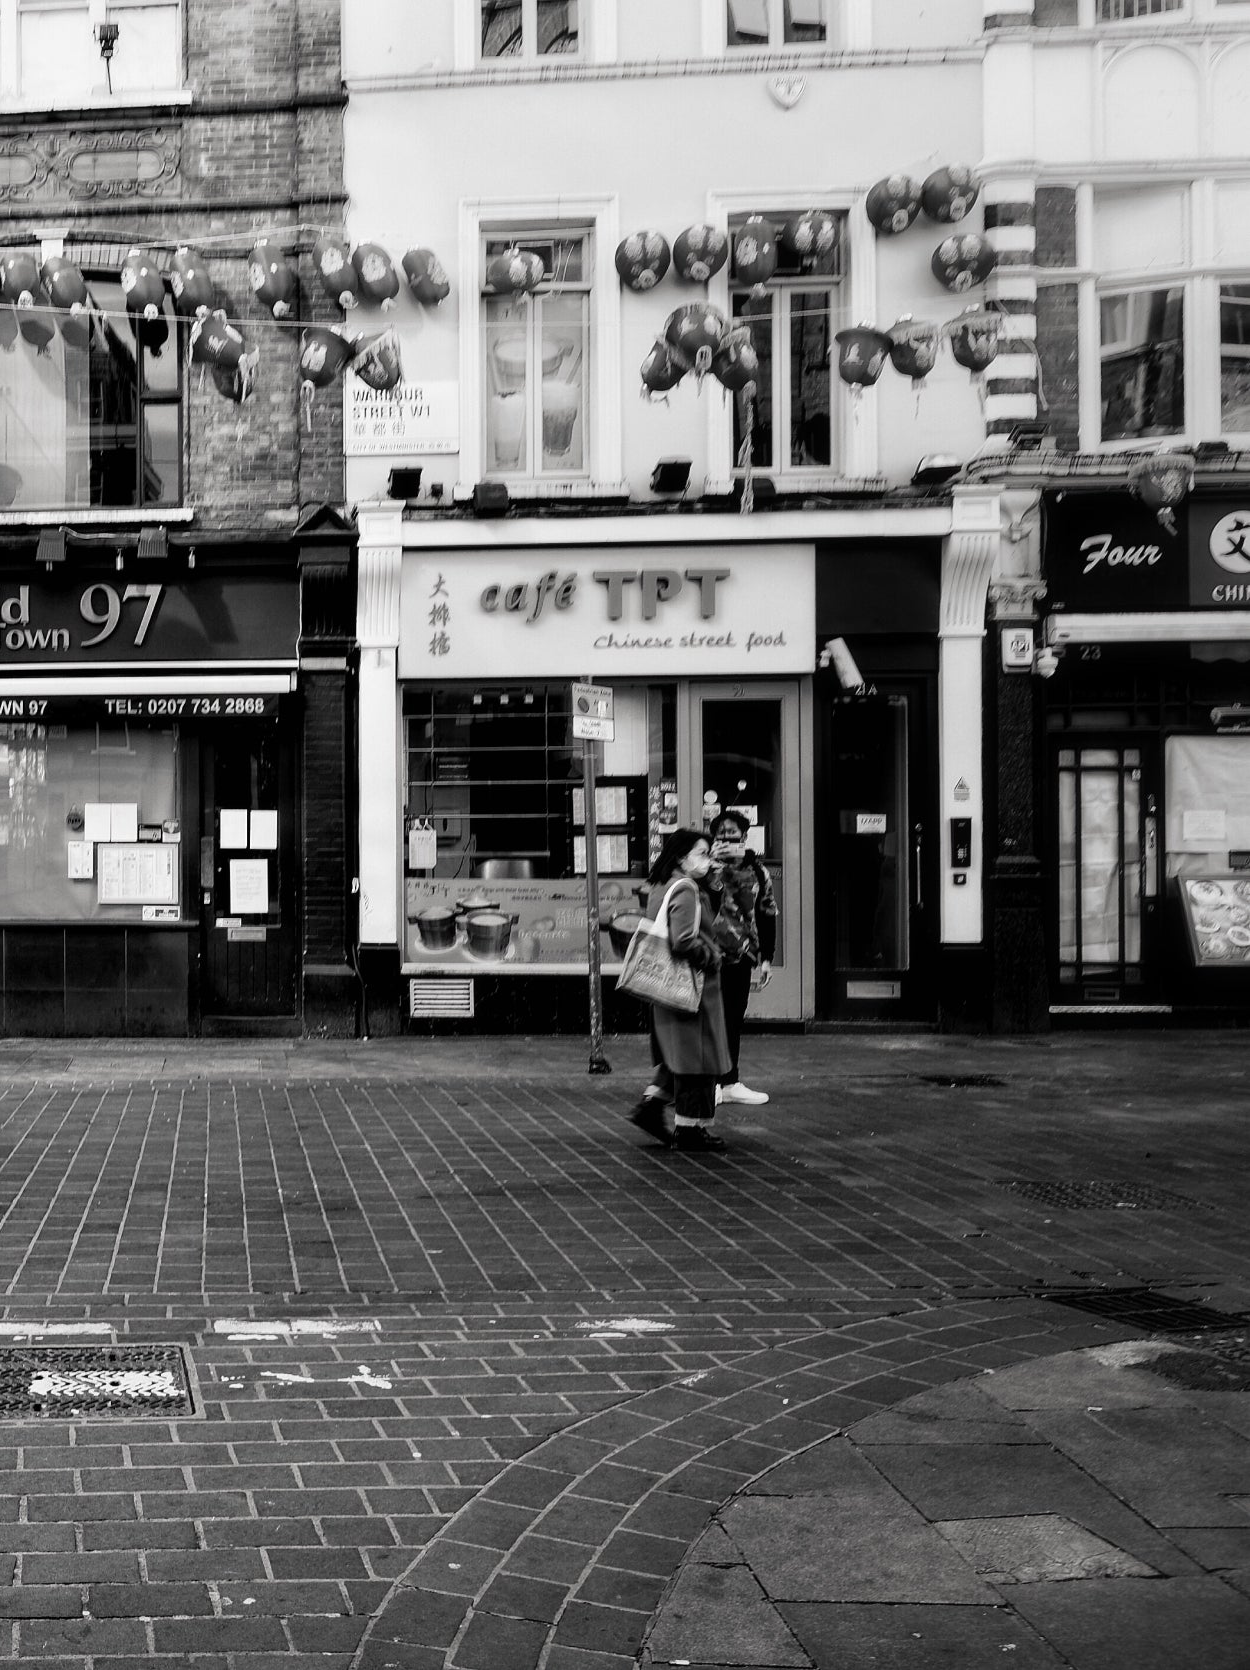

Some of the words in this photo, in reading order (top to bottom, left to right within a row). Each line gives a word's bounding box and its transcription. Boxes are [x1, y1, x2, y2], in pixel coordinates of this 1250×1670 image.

[353, 405, 404, 418] STREET
[410, 404, 430, 417] W1
[1079, 533, 1163, 575] Four
[479, 568, 578, 625] café
[592, 567, 731, 622] TPT
[1211, 584, 1250, 602] CHI
[79, 583, 163, 648] 97
[593, 633, 675, 650] Chinese
[678, 632, 737, 649] street
[746, 630, 787, 653] food
[1079, 644, 1102, 661] 23
[28, 700, 49, 716] 97
[104, 699, 143, 715] TEL:
[147, 698, 187, 715] 0207
[190, 698, 222, 715] 734
[224, 697, 265, 714] 2868
